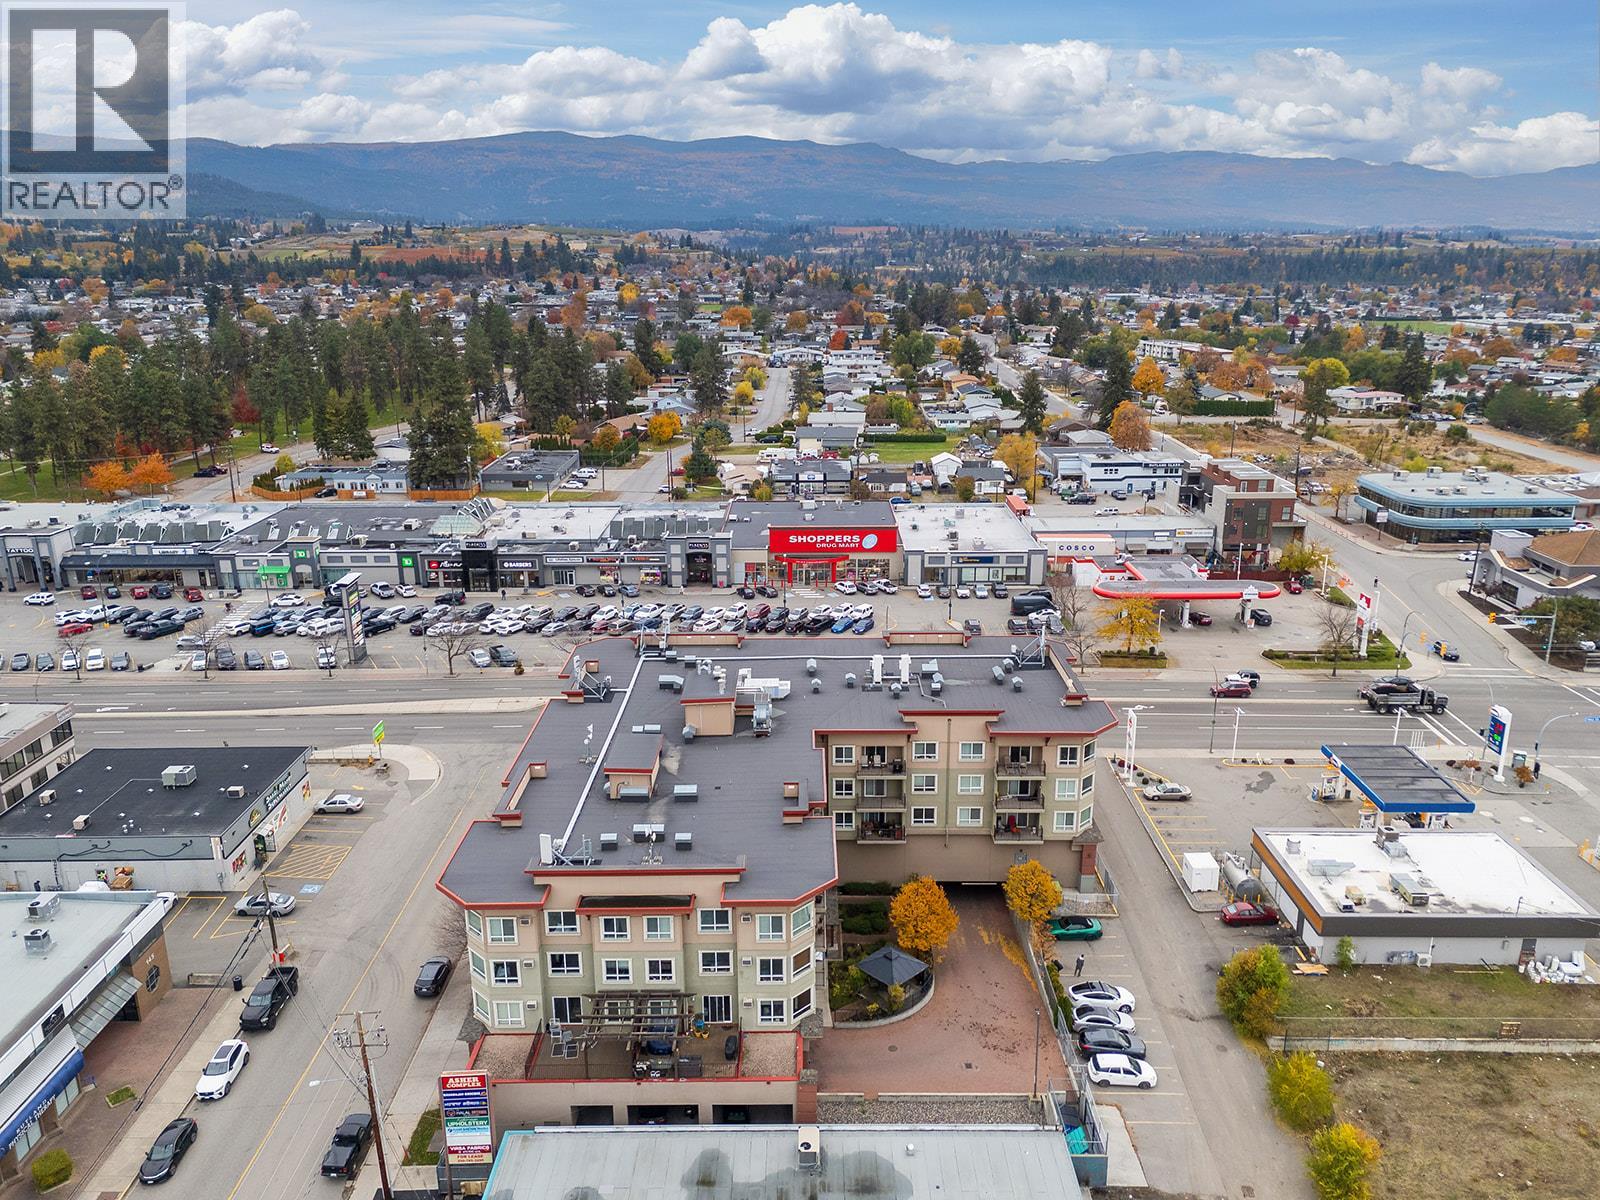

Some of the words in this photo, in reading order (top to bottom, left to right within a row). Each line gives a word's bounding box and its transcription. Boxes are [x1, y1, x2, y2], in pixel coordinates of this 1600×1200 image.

[788, 535, 860, 543] SHOPPERS
[8, 1120, 33, 1150] PHYSICAL
[34, 1094, 56, 1121] THERAPY
[16, 1099, 47, 1134] RUTLAND
